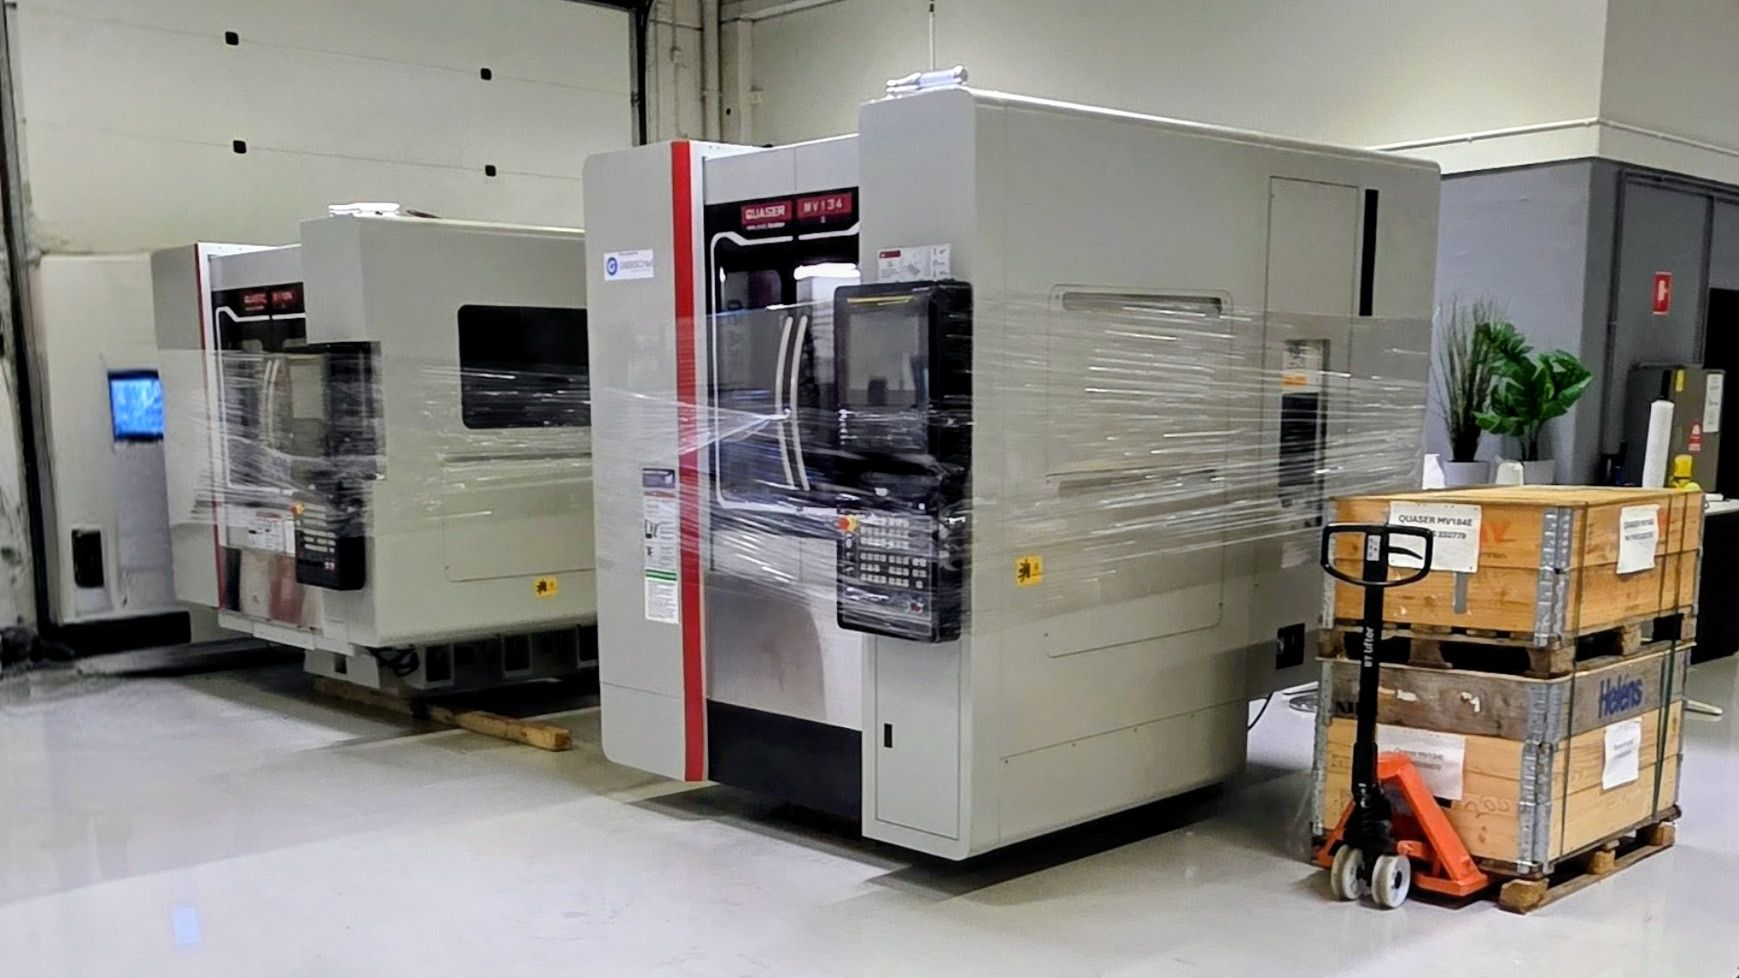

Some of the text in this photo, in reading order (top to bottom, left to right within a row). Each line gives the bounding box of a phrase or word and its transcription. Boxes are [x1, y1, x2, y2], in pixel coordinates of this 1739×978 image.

[745, 205, 786, 220] QUASER
[803, 199, 842, 213] MV134
[1399, 514, 1435, 524] QUASER
